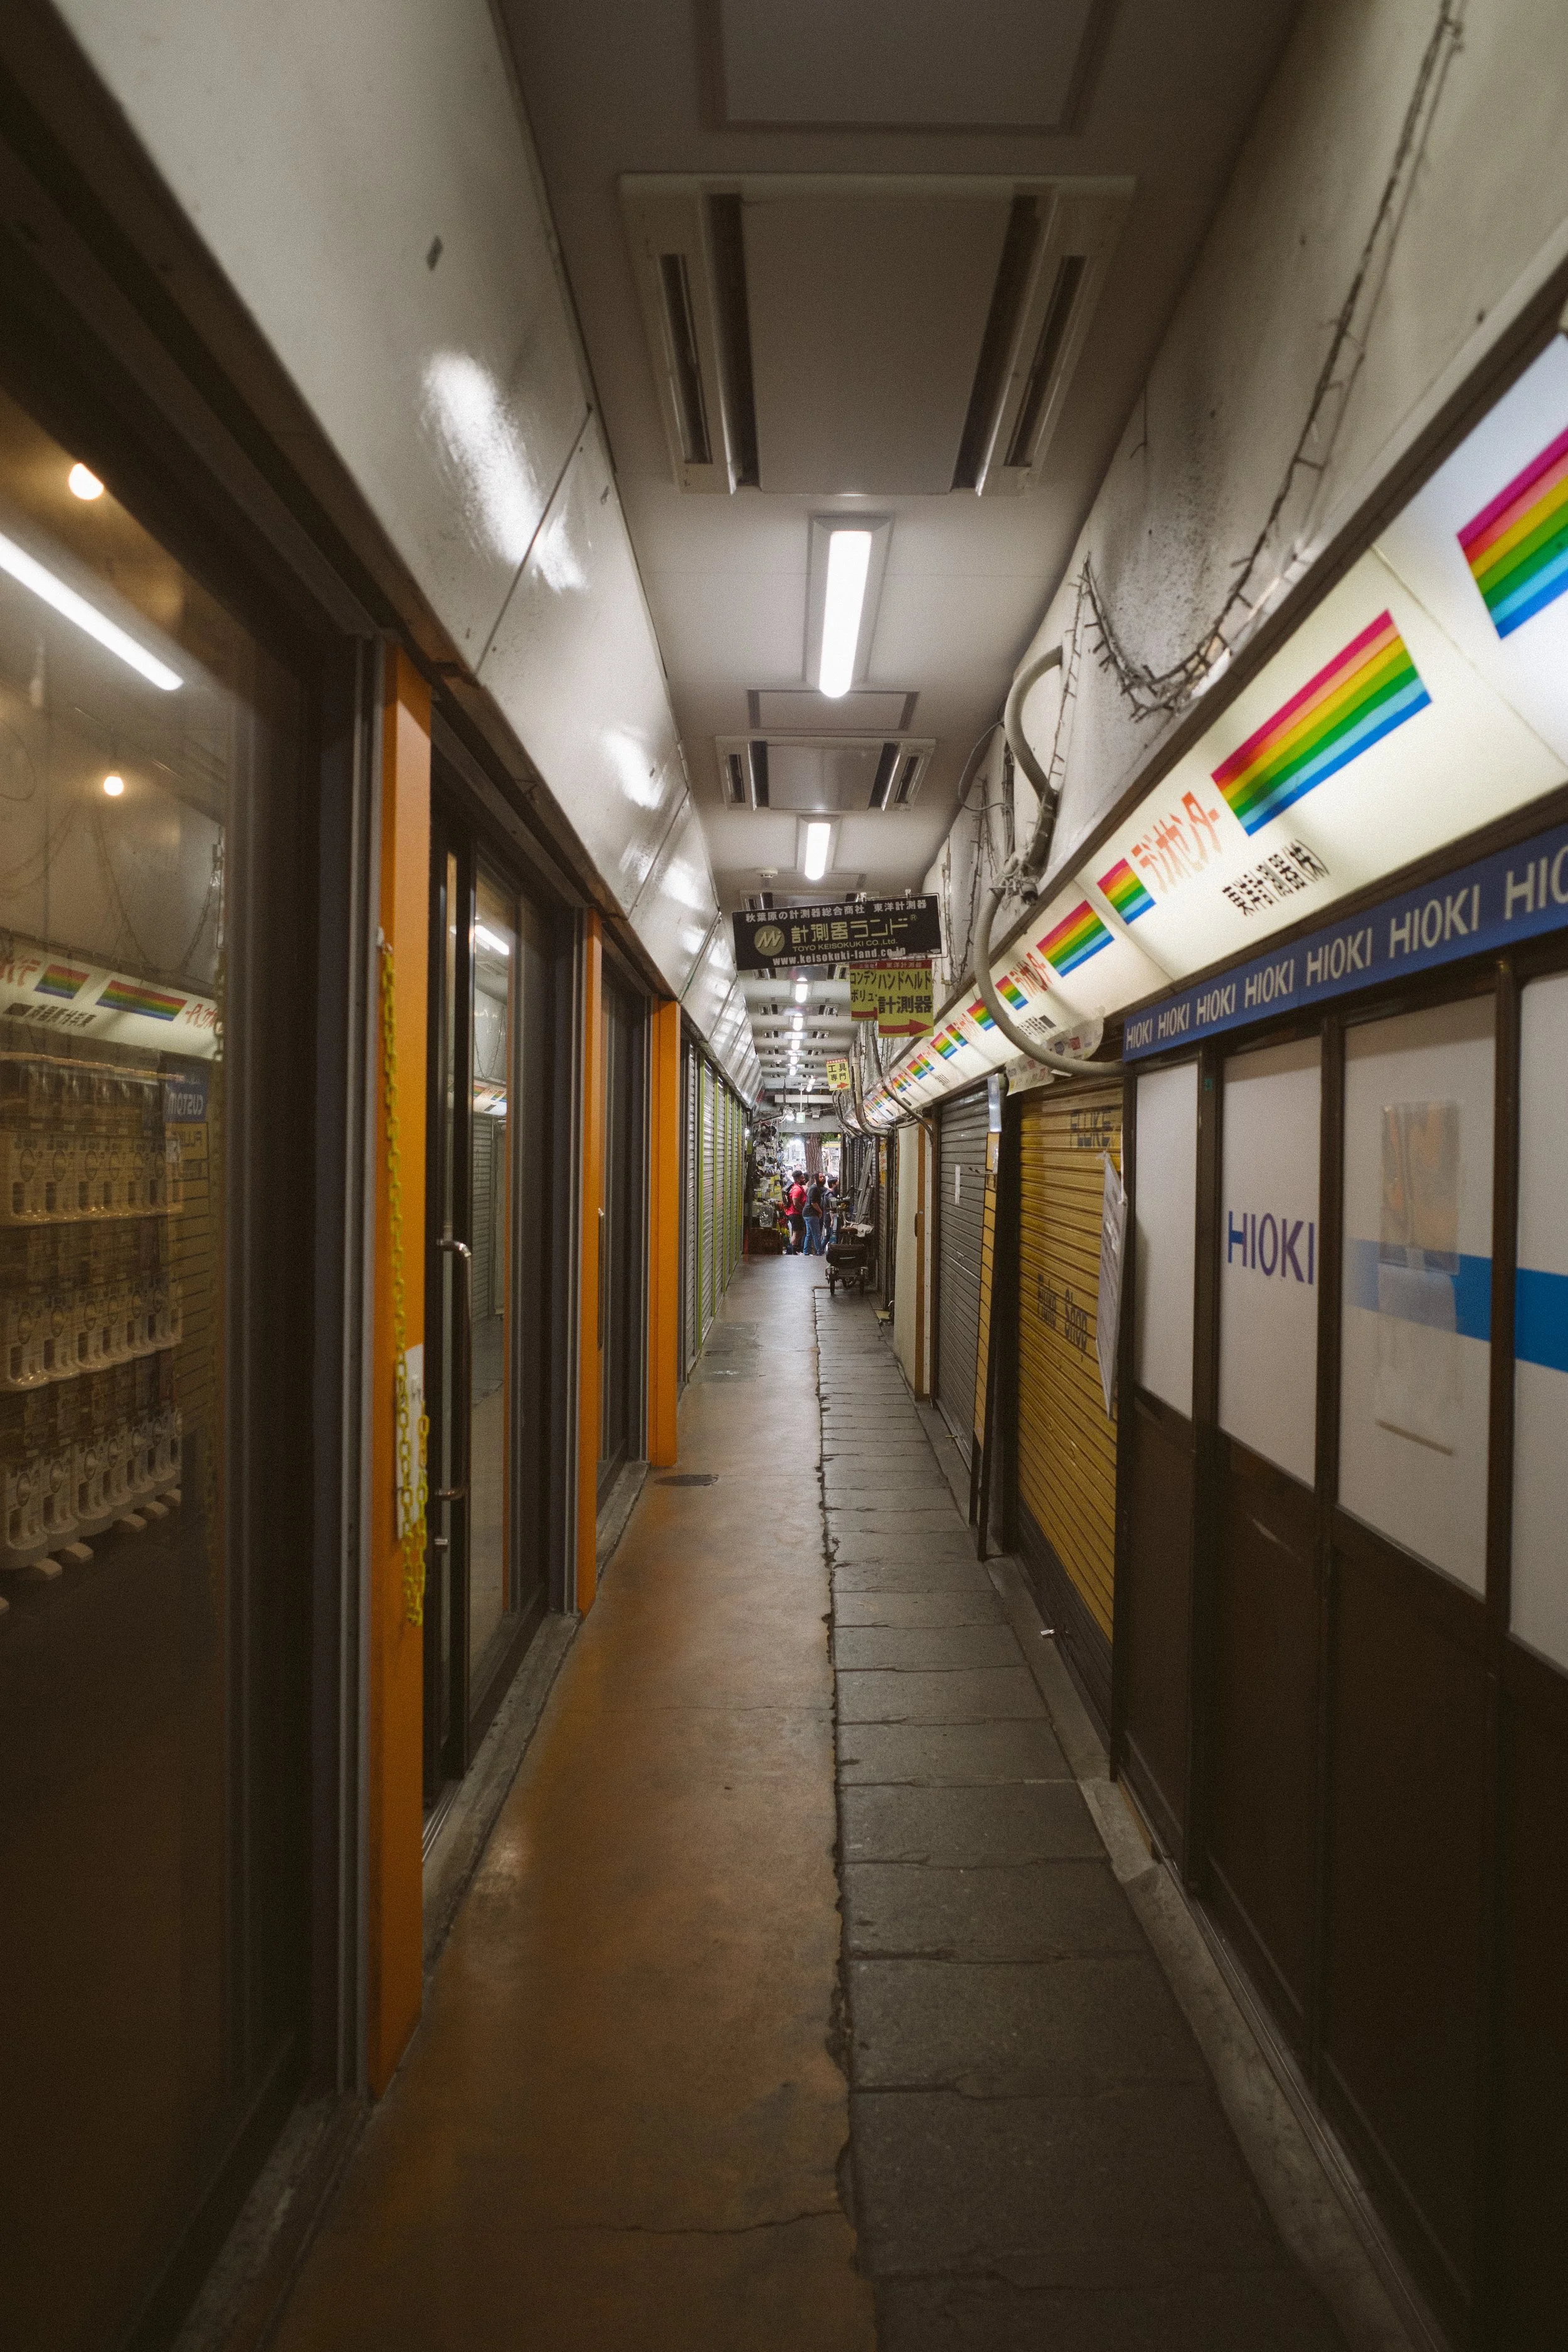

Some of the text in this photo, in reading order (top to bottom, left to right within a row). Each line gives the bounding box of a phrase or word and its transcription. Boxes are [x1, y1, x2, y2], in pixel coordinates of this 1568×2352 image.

[745, 899, 927, 923] 秋葉原の計測器総合商社 東洋計測器
[818, 941, 864, 950] KEISOKUKI
[772, 946, 906, 966] www.keisokuki-land.cojp
[1125, 1018, 1153, 1051] HIOKI
[1158, 1002, 1190, 1039] HIOKI
[1195, 983, 1236, 1025] HIOKI
[1244, 958, 1295, 1009] HIOKI
[1306, 927, 1372, 987] HIOKI
[1389, 883, 1481, 959] HIOKI
[878, 971, 931, 990] ハンドヘルド
[878, 995, 933, 1014] 計測器
[828, 1062, 847, 1073] 工具
[1070, 1108, 1111, 1147] FLUKE
[1227, 1210, 1315, 1285] HIOKI
